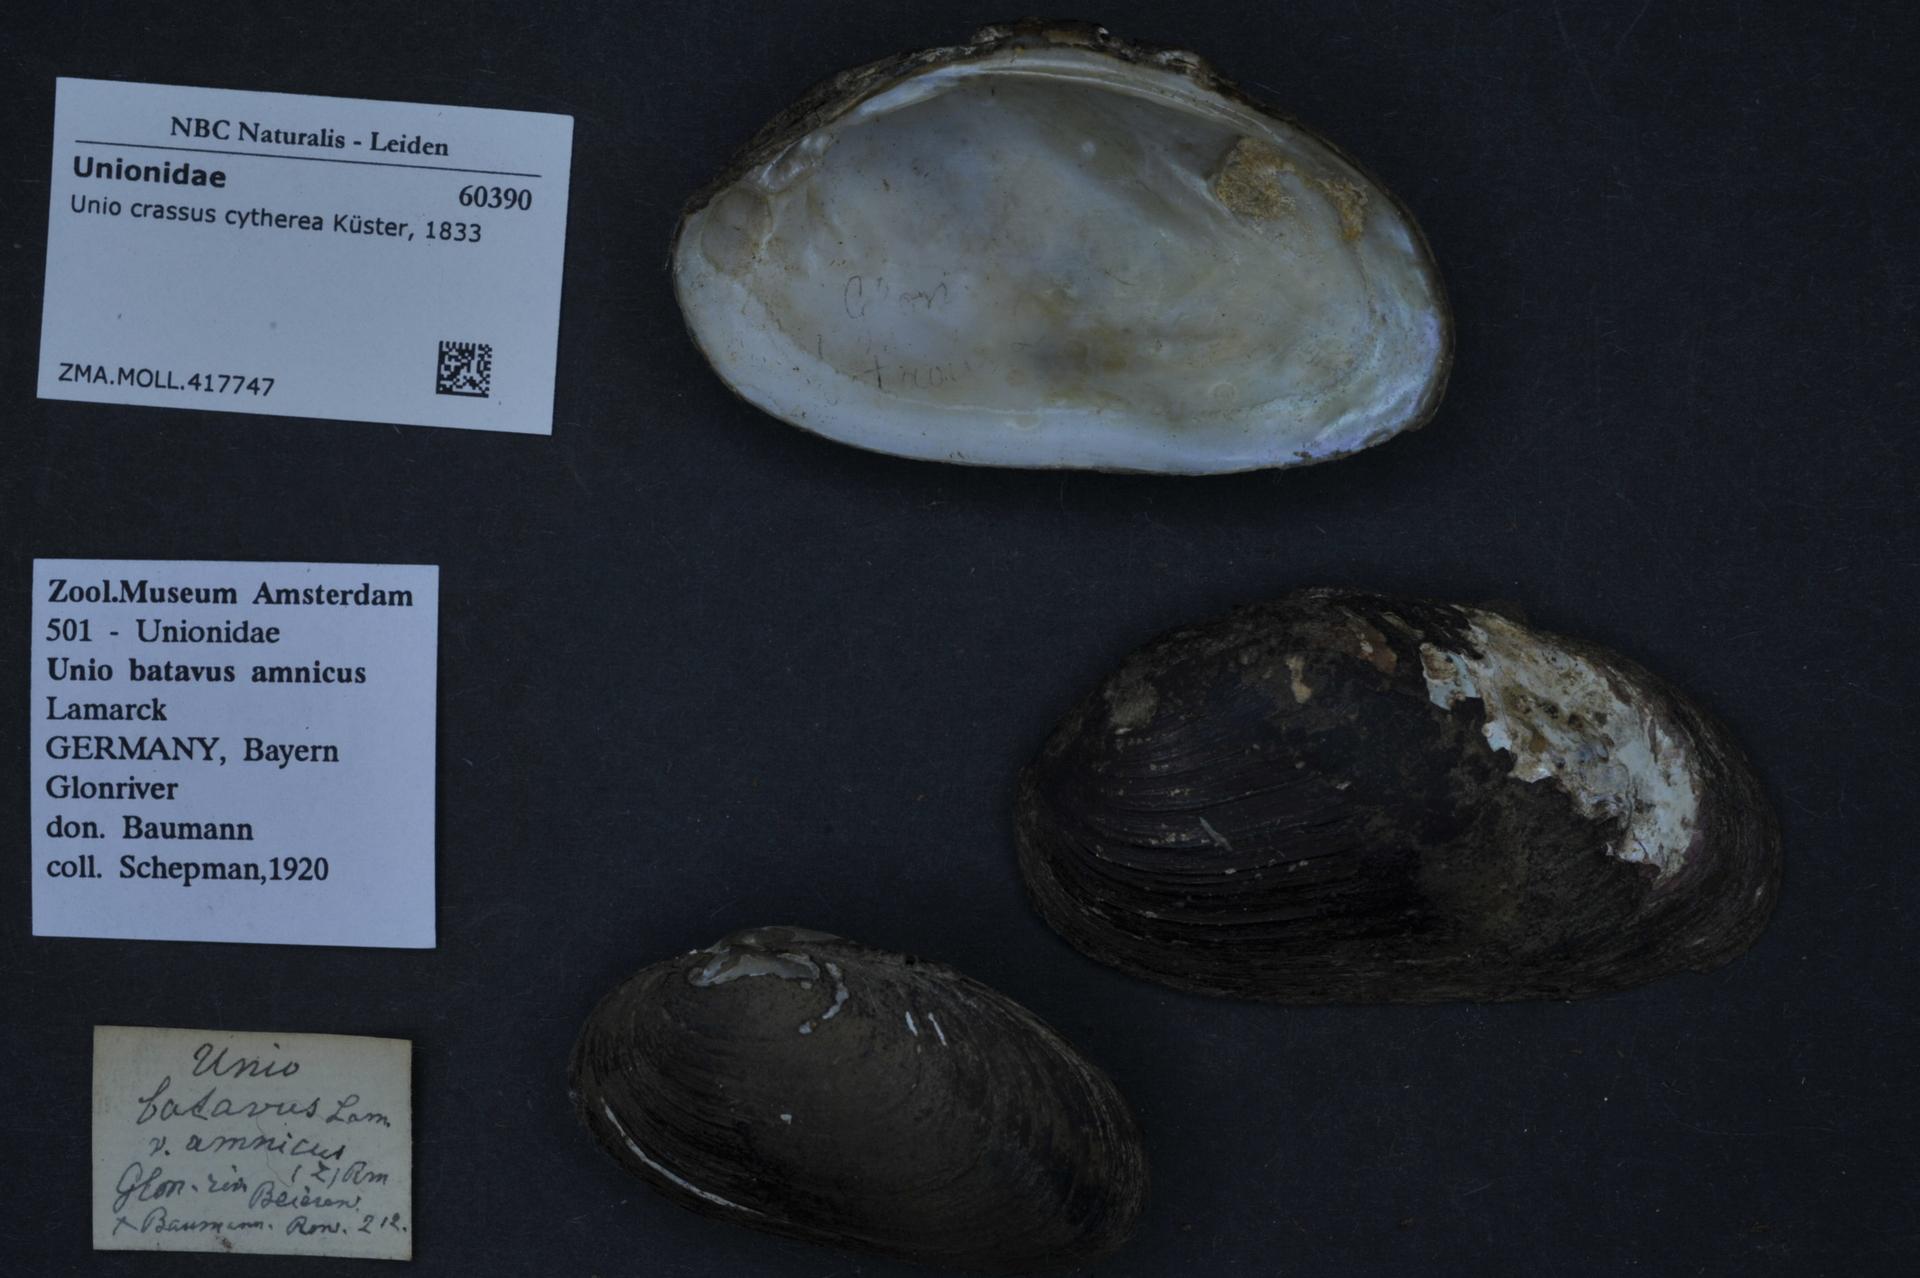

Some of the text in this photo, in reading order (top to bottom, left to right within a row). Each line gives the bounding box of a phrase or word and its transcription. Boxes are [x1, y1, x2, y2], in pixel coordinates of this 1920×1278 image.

[171, 117, 230, 140] NBC
[238, 122, 345, 148] Naturalis
[370, 132, 448, 156] Leiden
[73, 156, 227, 188] Unionidae
[459, 185, 532, 210] 60390
[72, 194, 481, 242] Unio crassus cytherea Küster, 1833
[58, 363, 275, 396] ZMA.MOLL.417747
[48, 579, 413, 606] Zool.Museum Amsterdam
[46, 618, 92, 641] 501
[136, 619, 280, 643] Unionidae
[47, 657, 366, 683] Unio batavus amnicus
[47, 696, 167, 721] Lamarck
[46, 736, 339, 769] GERMANY, Bayern
[46, 775, 178, 800] Glonriver
[46, 815, 253, 840] don. Baumann
[47, 855, 328, 887] coll. Schepman,1920
[193, 1042, 300, 1078] Unio
[136, 1076, 391, 1127] batavus Lam.
[186, 1132, 346, 1160] amnicus
